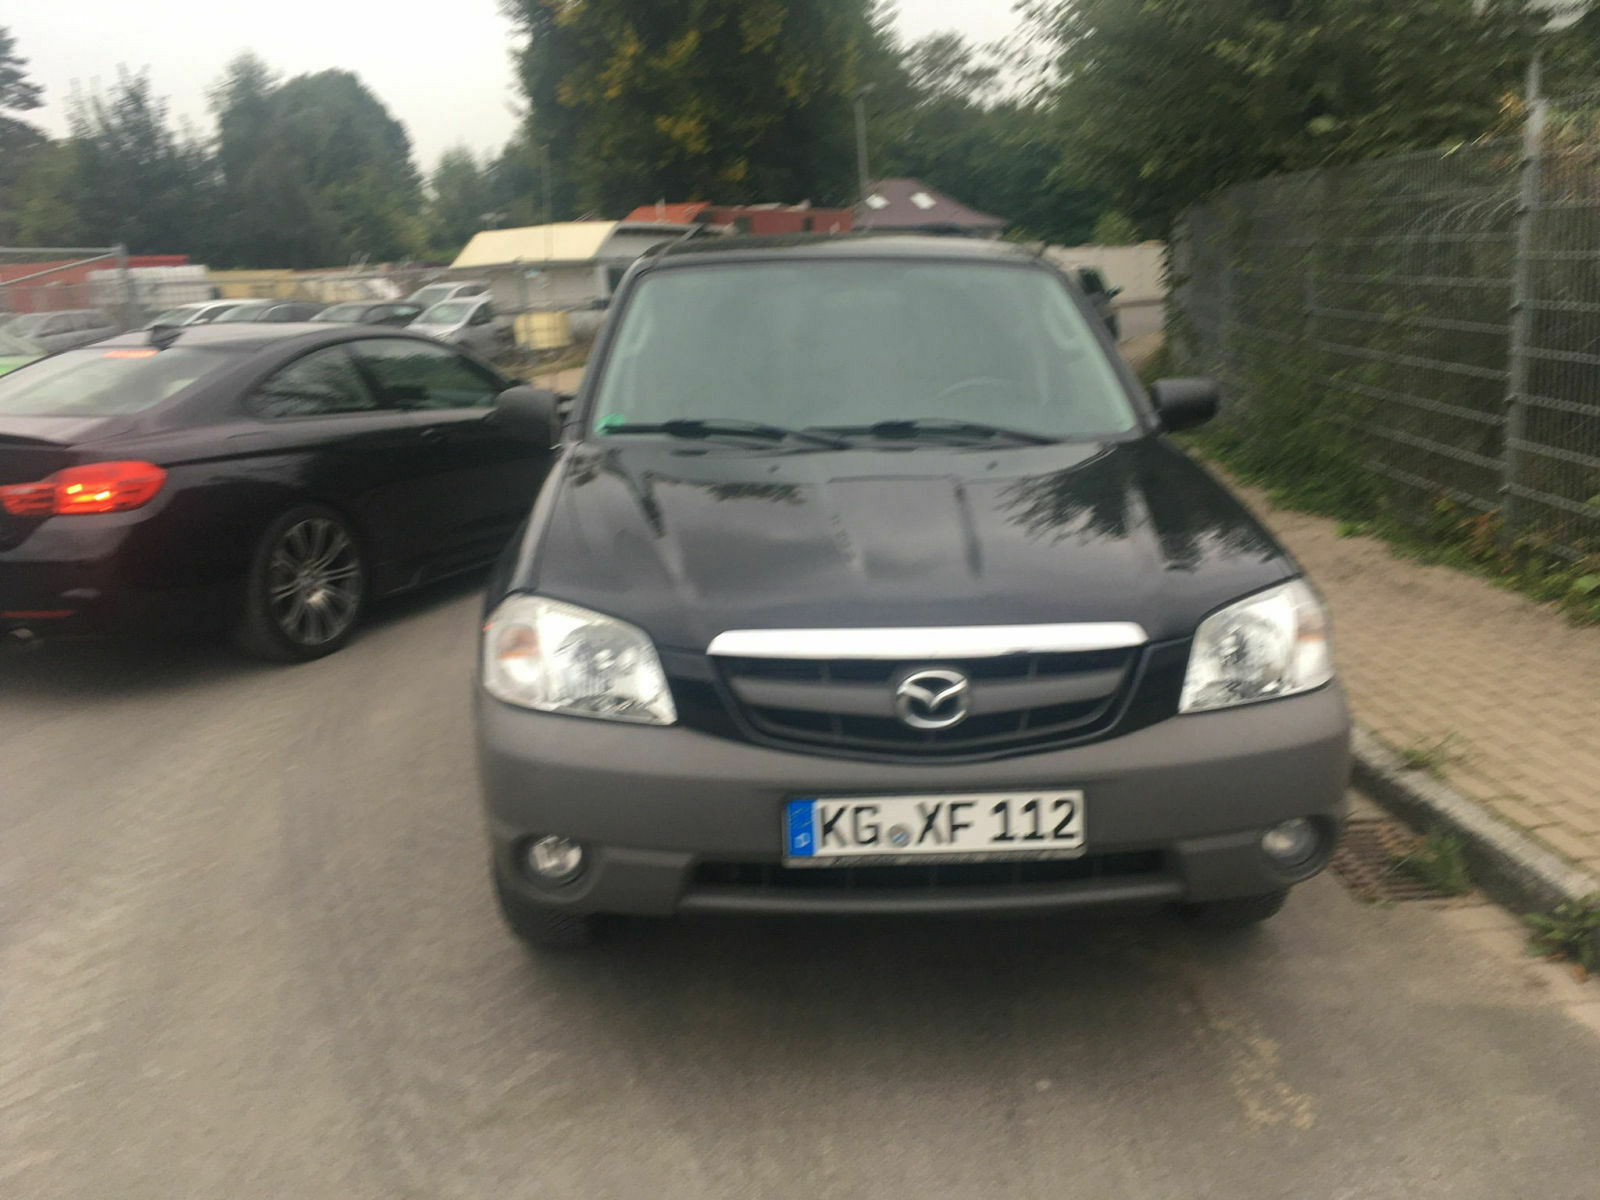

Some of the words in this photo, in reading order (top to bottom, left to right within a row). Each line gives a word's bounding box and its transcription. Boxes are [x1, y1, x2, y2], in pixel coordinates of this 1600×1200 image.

[819, 803, 880, 847] KG
[915, 801, 977, 845] XF
[990, 798, 1077, 842] 112
